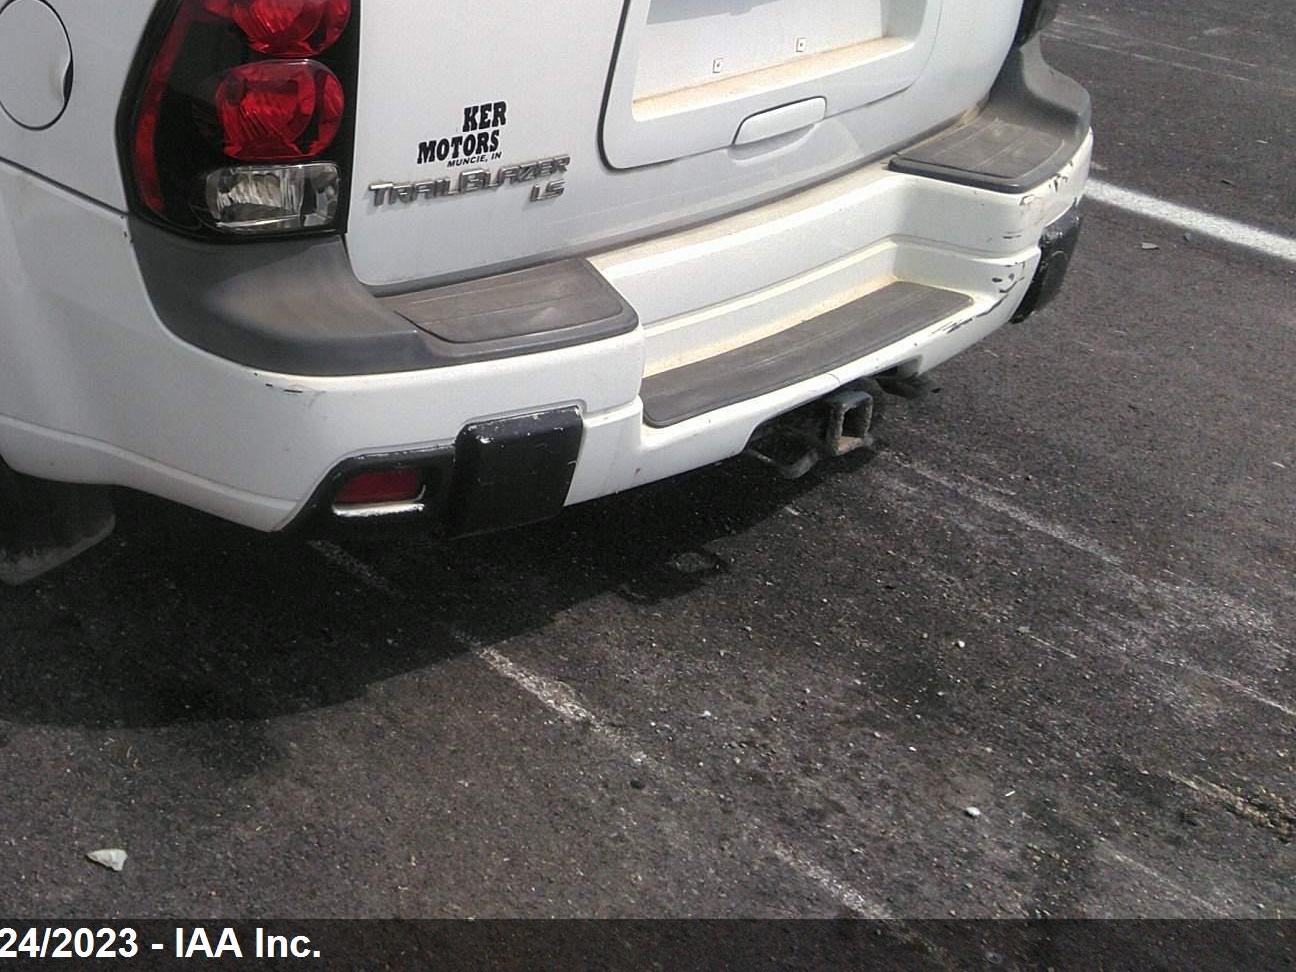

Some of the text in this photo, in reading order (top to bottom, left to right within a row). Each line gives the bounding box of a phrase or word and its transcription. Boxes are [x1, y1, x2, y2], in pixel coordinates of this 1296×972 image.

[463, 101, 507, 132] KER
[417, 129, 500, 164] MOTORS
[447, 152, 502, 167] MUNCIE, IN
[529, 180, 565, 203] LS
